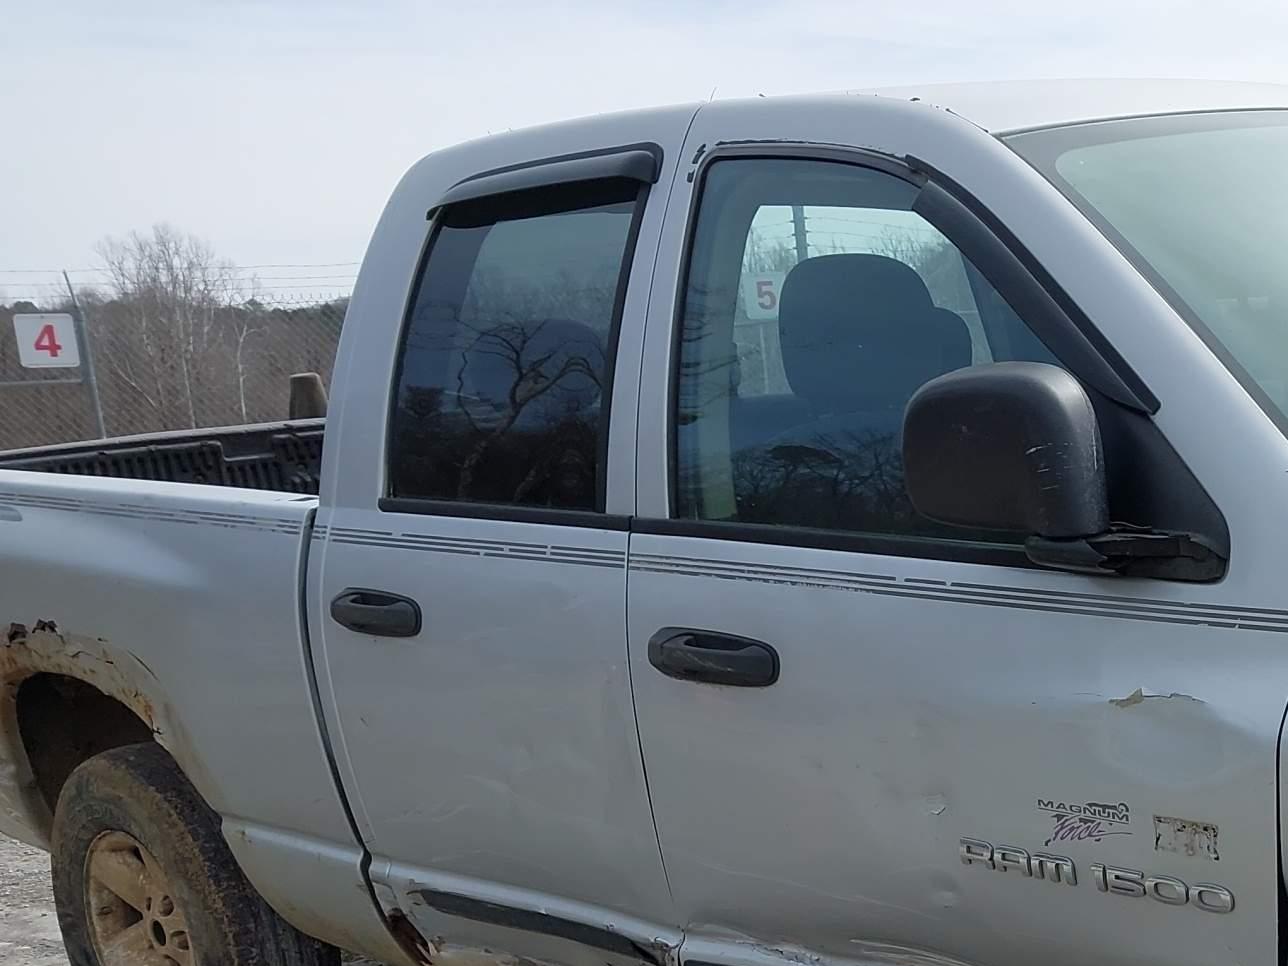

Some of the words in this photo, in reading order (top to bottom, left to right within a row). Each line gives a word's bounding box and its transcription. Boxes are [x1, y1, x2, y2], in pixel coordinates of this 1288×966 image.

[756, 280, 777, 310] 5
[34, 324, 63, 357] 4
[1037, 799, 1130, 823] MAGNUM
[959, 836, 1079, 887] RAM
[1089, 862, 1236, 914] 1500
